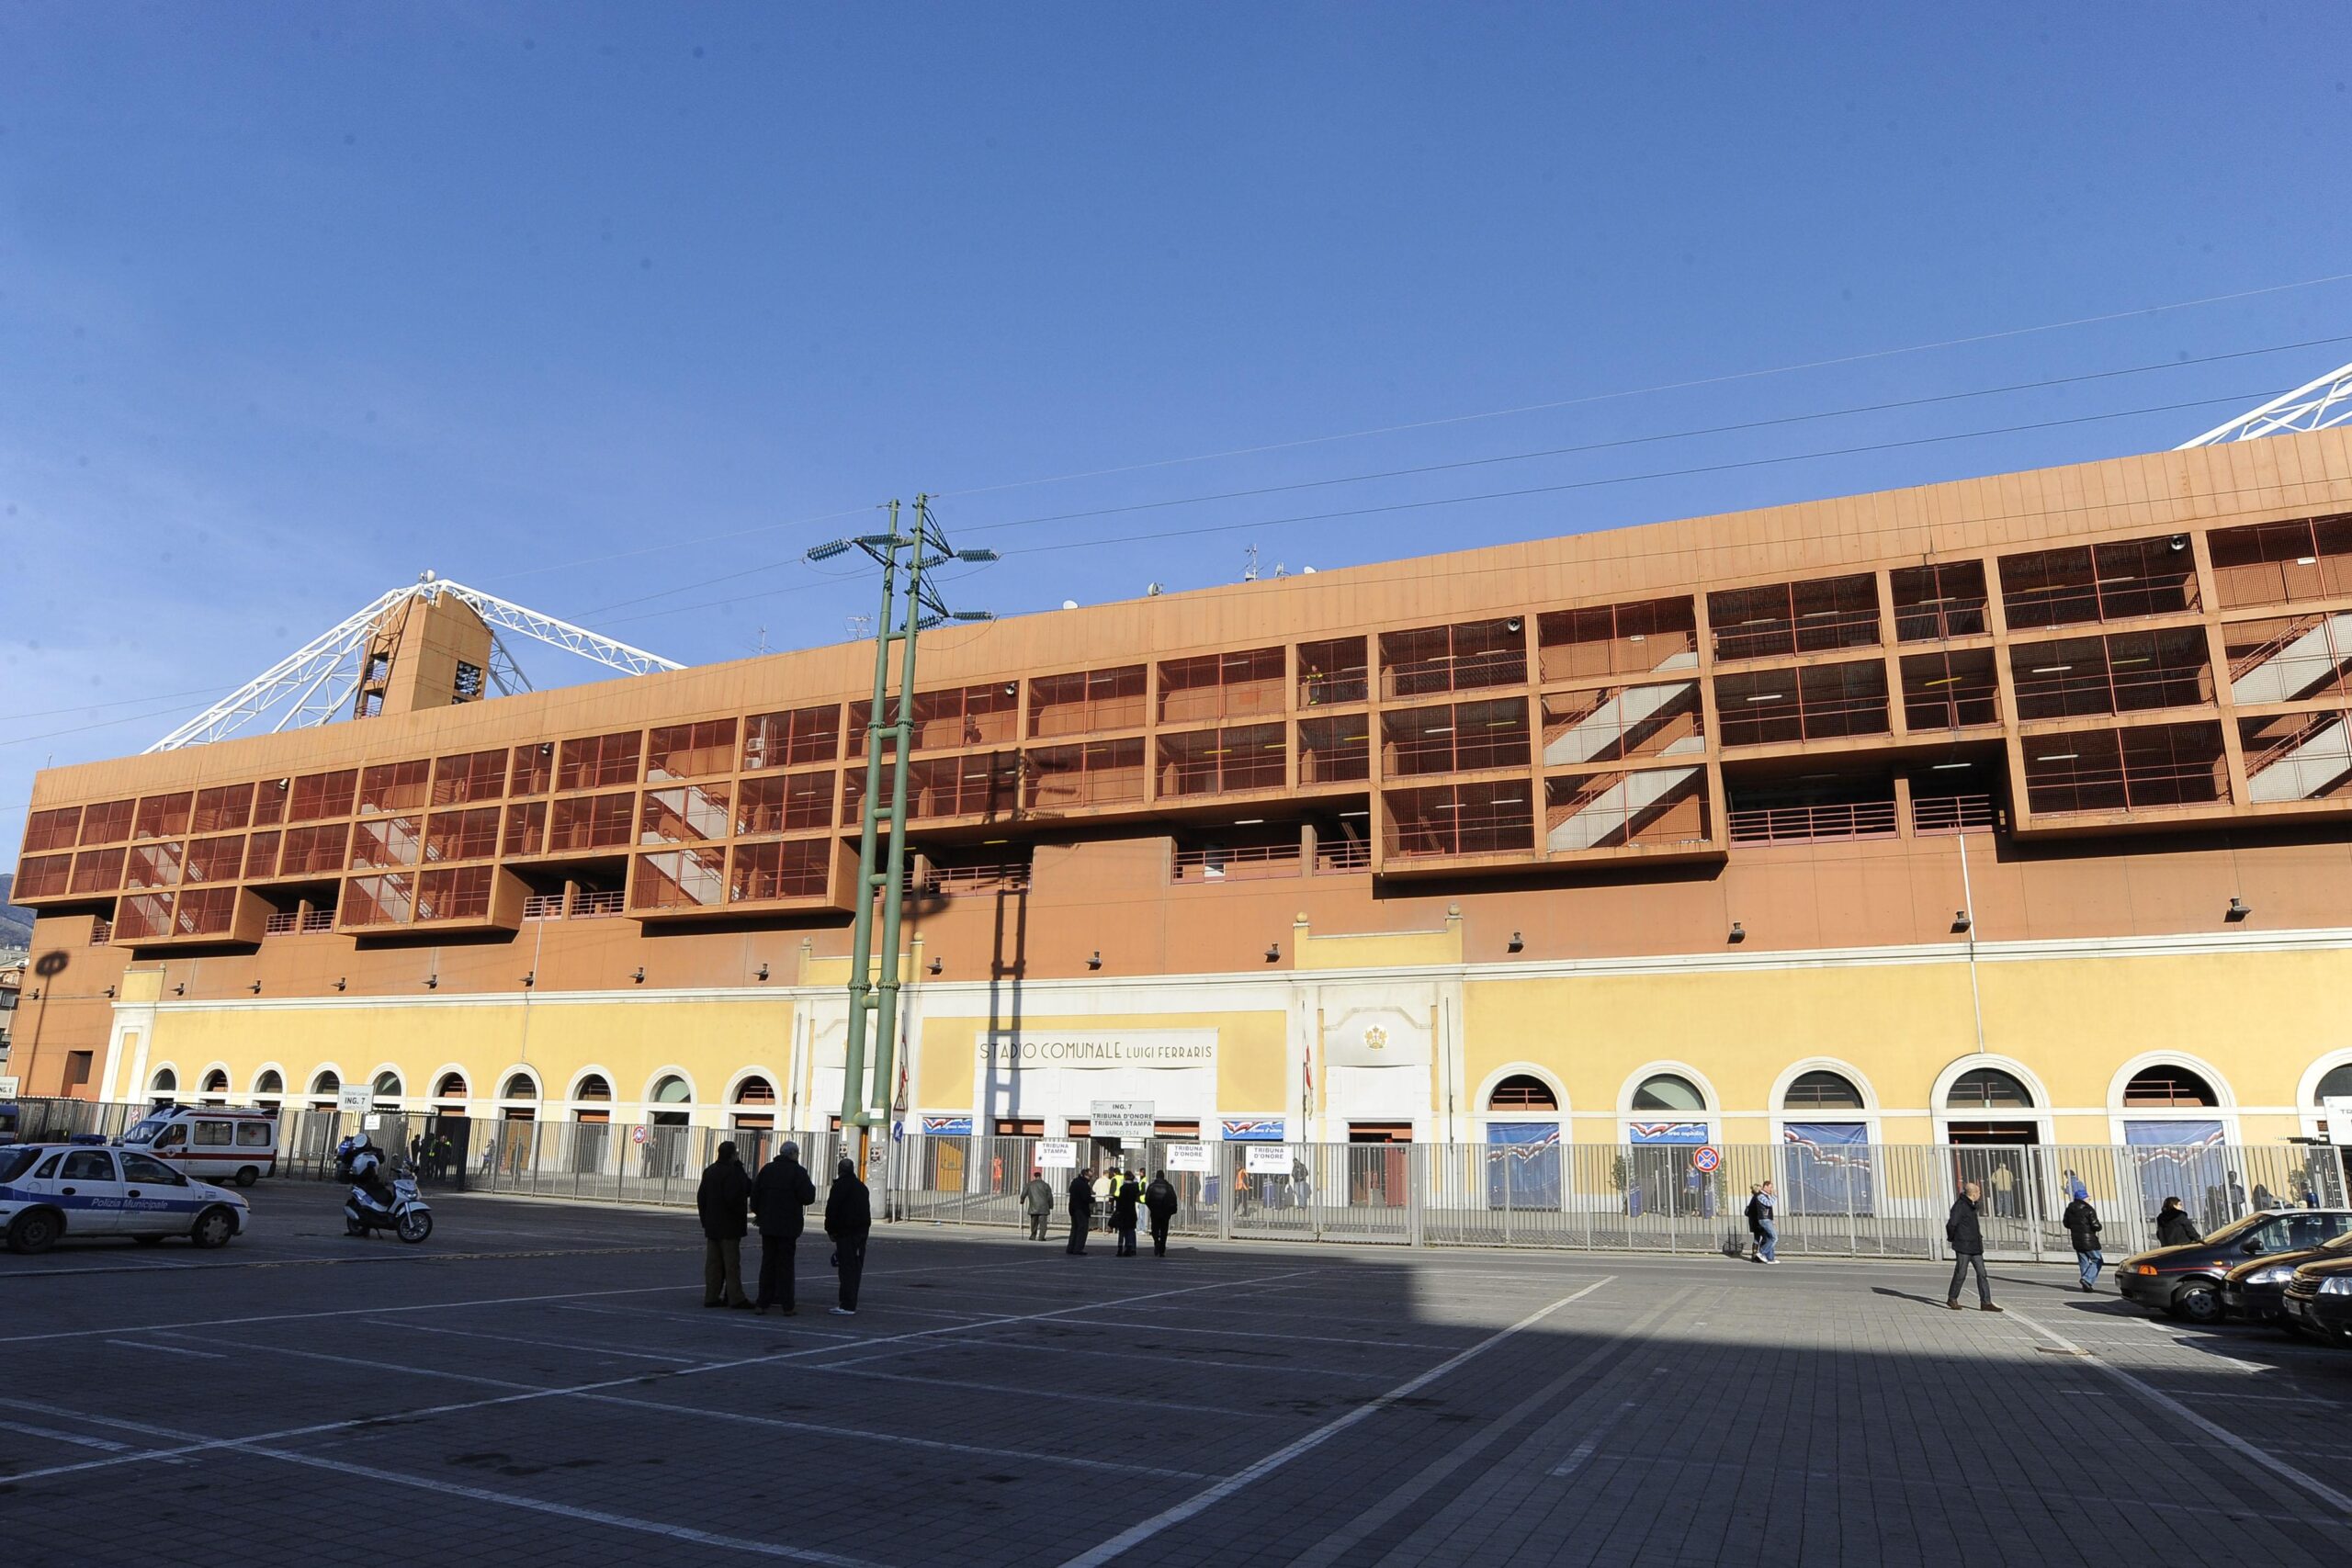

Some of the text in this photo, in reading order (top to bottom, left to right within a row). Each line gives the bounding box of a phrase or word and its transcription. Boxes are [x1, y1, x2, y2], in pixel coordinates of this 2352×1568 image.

[979, 1042, 1213, 1059] STADIO COMUNALE LUIGI FERRARIS
[345, 1097, 366, 1105] ING. 7
[91, 1198, 168, 1210] Polizia Municipale
